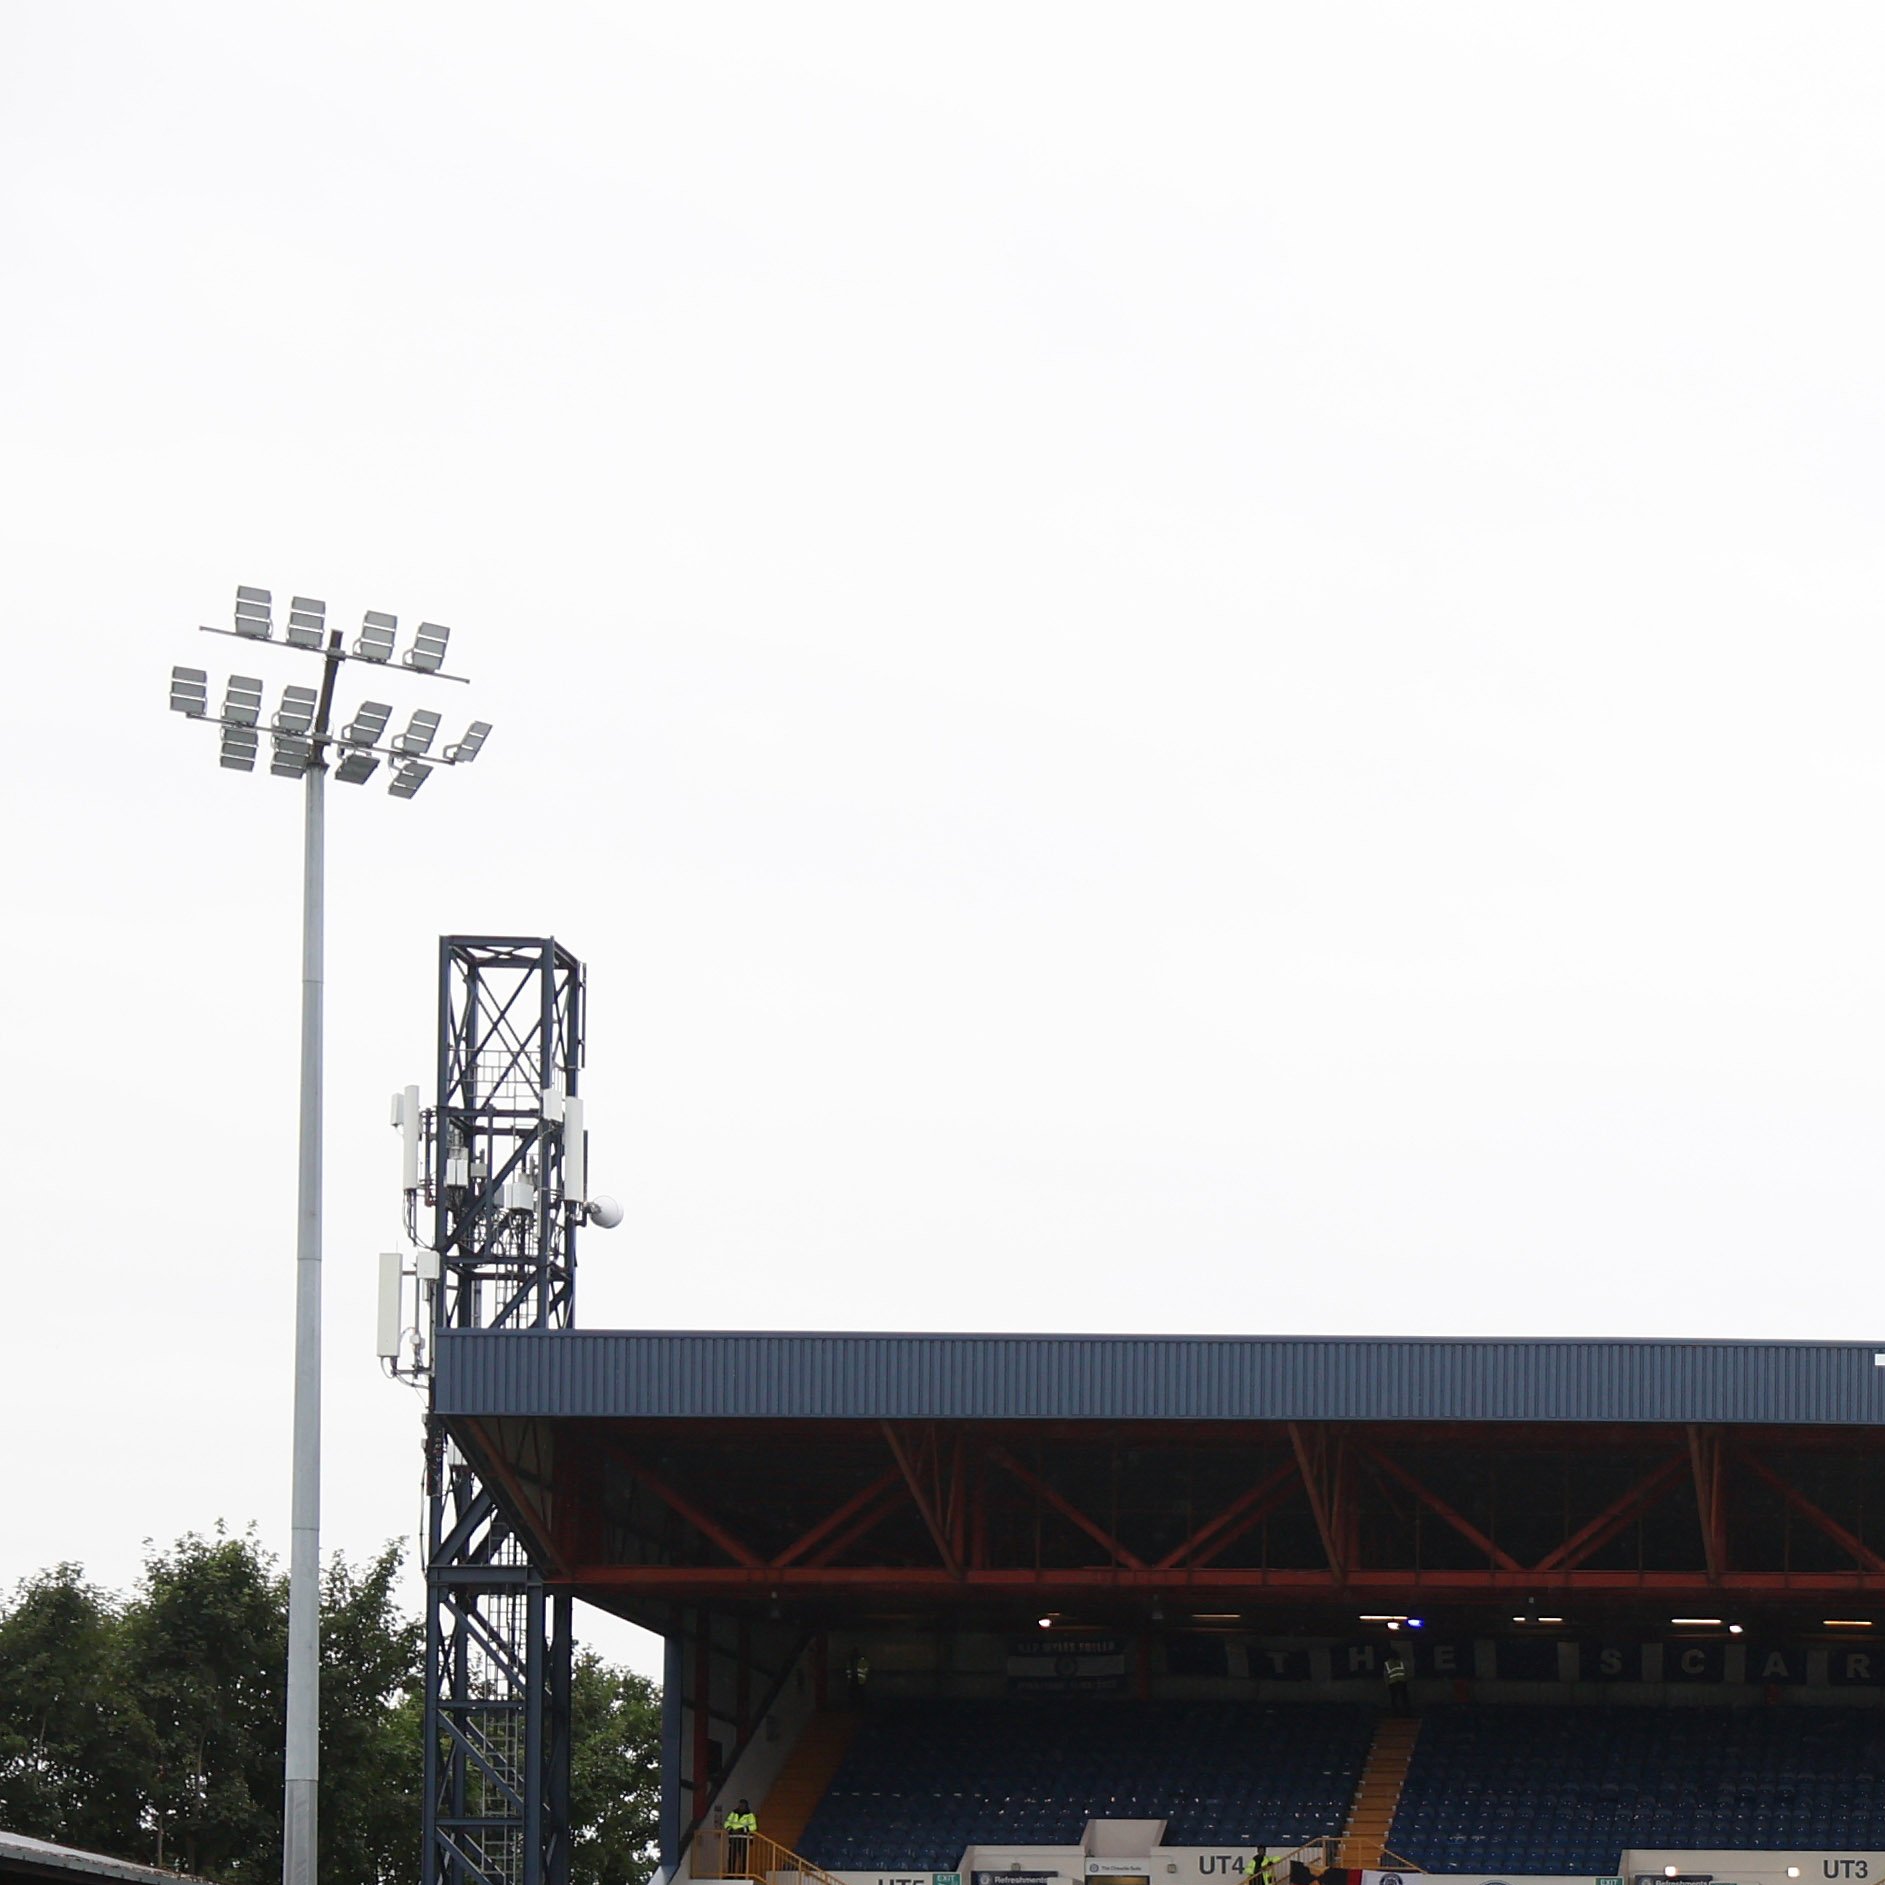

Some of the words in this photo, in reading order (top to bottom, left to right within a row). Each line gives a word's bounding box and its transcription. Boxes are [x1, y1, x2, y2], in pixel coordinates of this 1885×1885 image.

[1199, 1855, 1245, 1876] UT4
[1823, 1859, 1868, 1879] UT3
[936, 1874, 954, 1883] EXIT
